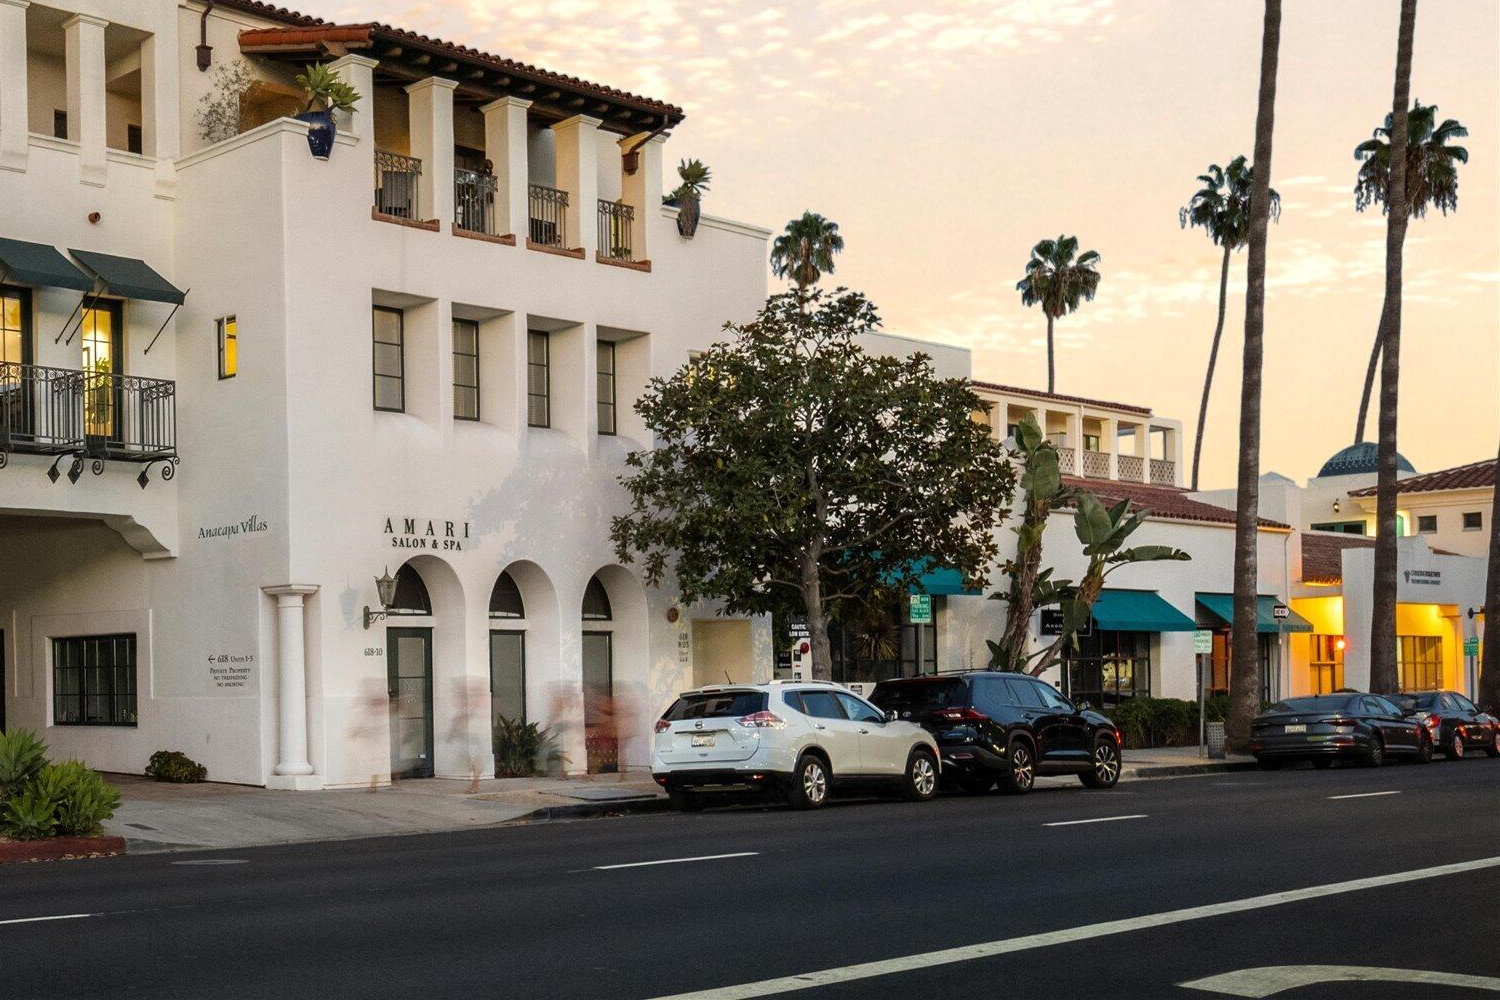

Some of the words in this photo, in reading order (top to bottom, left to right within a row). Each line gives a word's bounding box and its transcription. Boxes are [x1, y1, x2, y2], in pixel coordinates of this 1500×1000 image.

[198, 525, 240, 539] Anacapa
[240, 514, 268, 533] Villas
[383, 517, 469, 538] AMARI
[392, 537, 426, 548] SALON
[431, 539, 438, 549] &
[443, 540, 462, 551] SPA
[217, 654, 229, 663] 618
